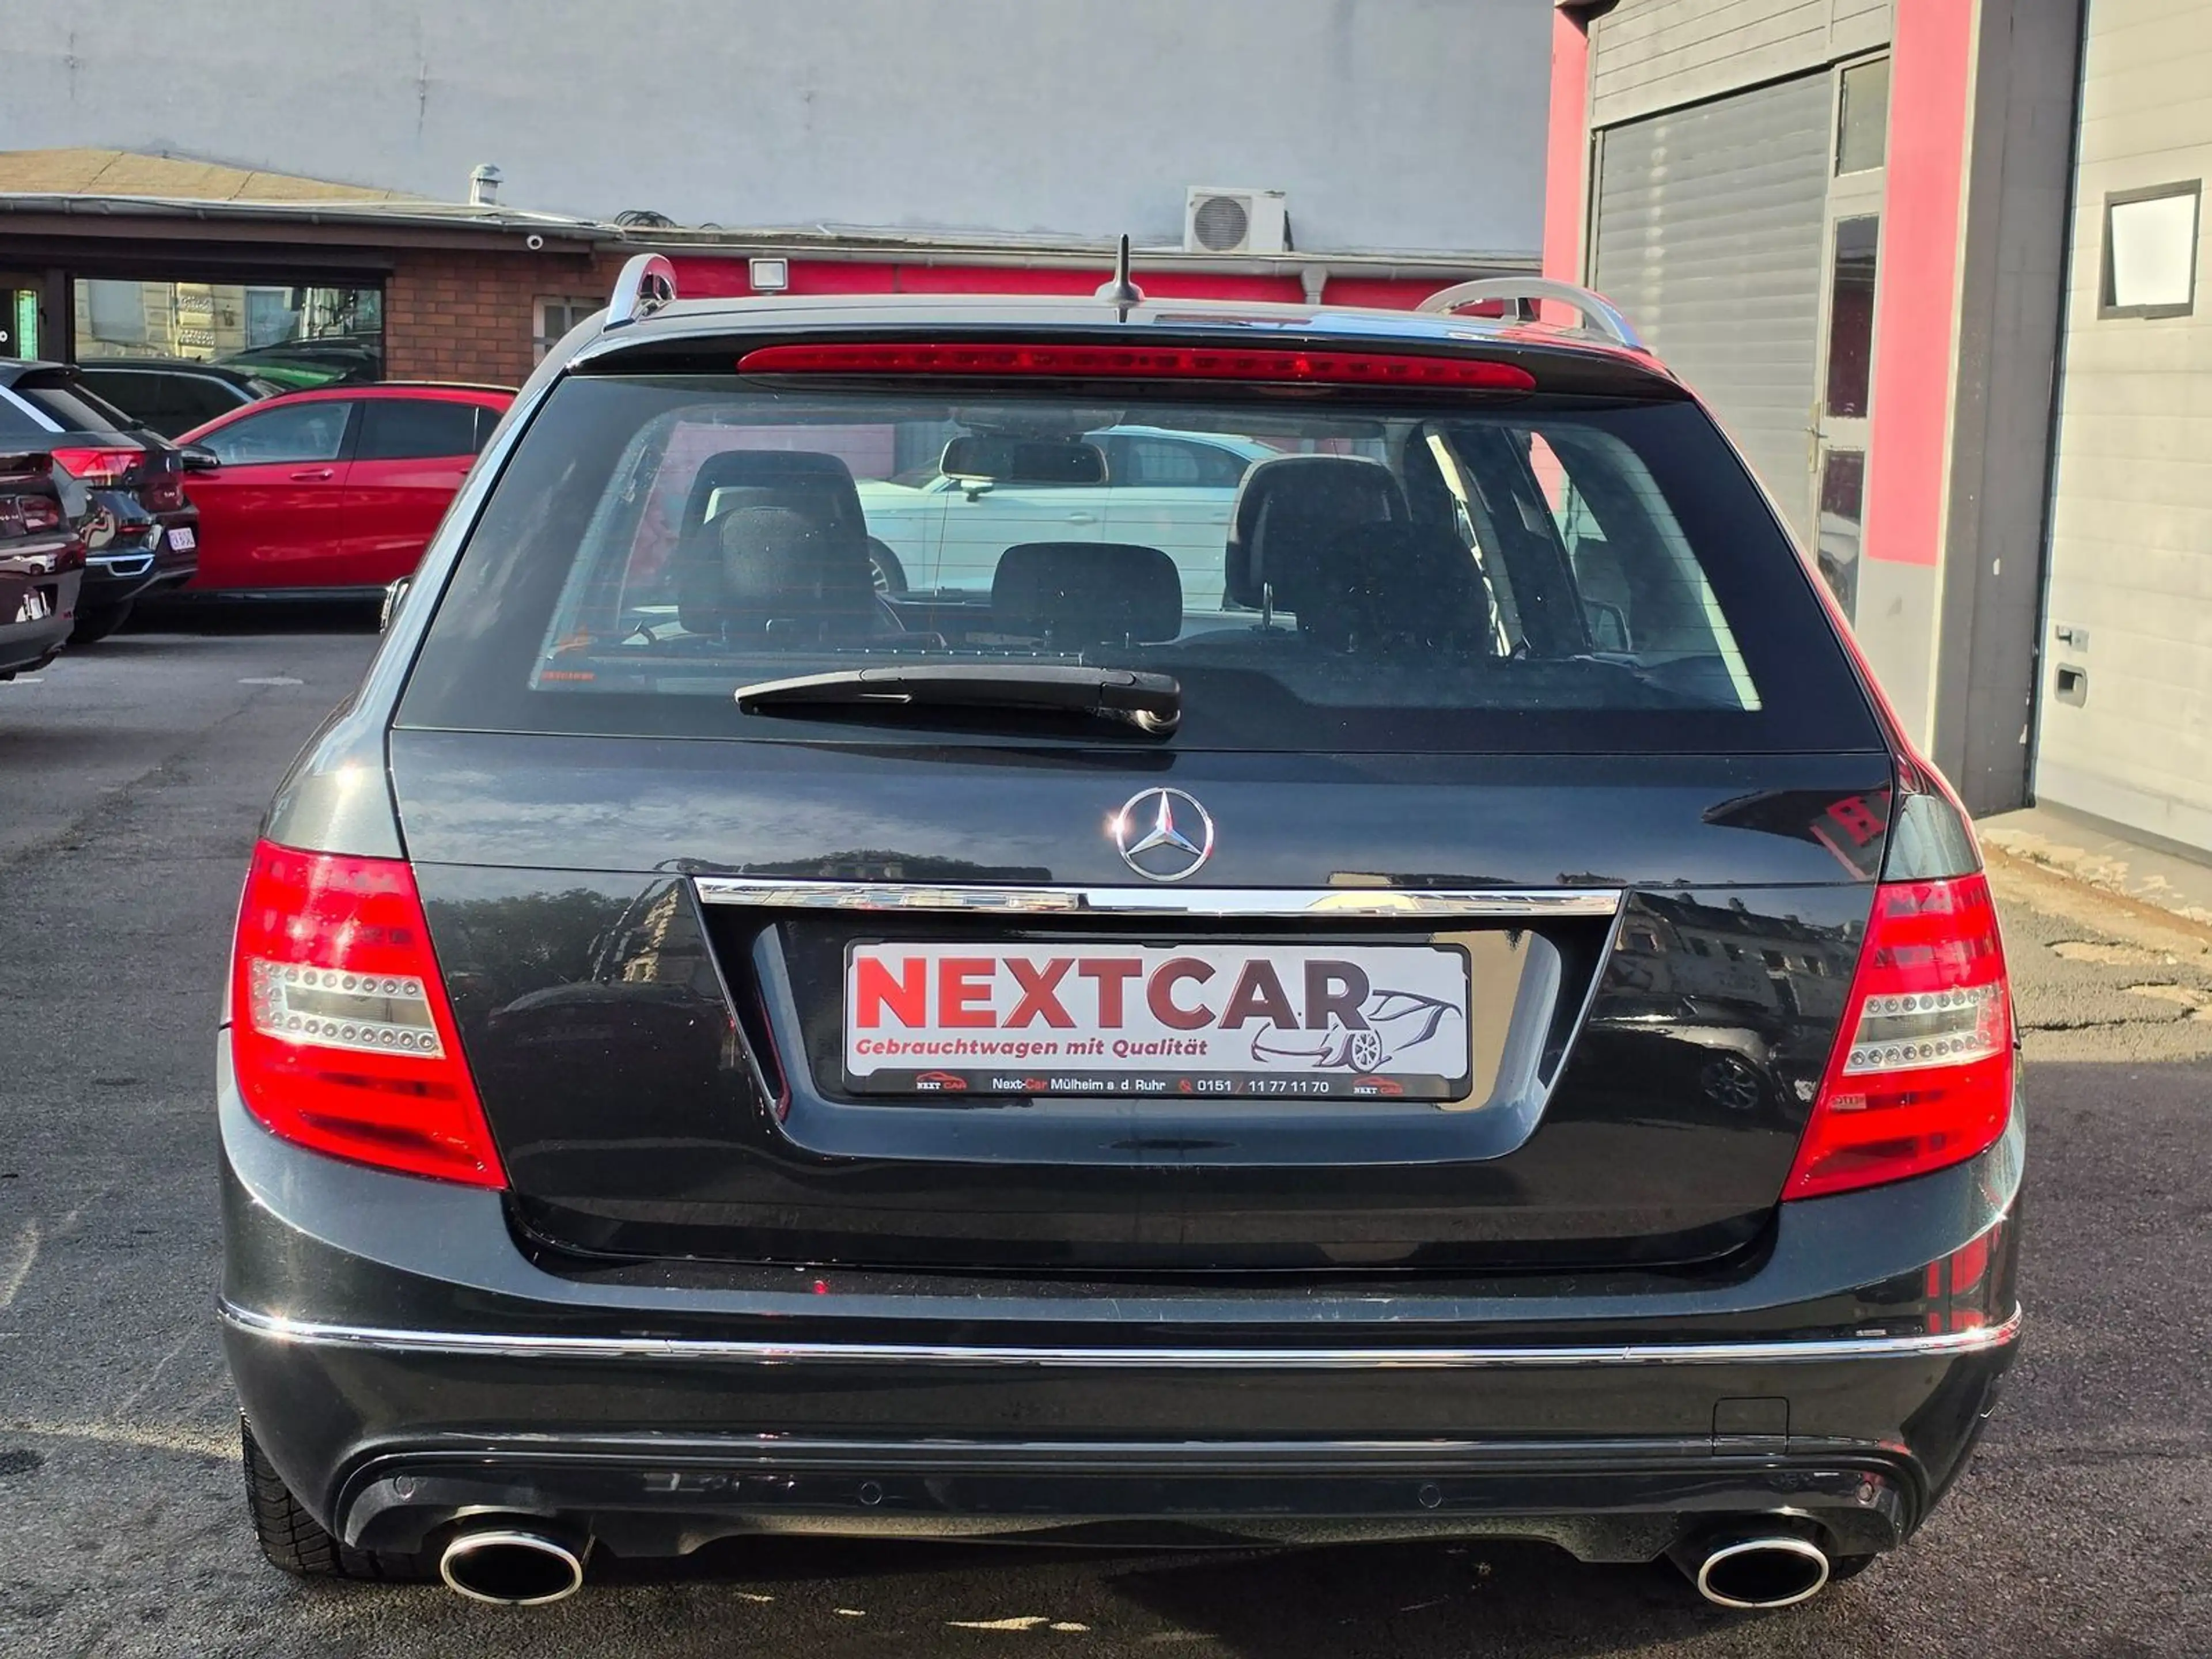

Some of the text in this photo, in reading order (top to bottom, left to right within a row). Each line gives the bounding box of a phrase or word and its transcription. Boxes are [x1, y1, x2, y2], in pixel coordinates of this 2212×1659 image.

[857, 957, 1371, 1031] NEXTCAR
[856, 1038, 1208, 1059] Gebrauchtwagen mit Qualität
[1050, 1078, 1103, 1090] Mülheim
[1135, 1079, 1166, 1090] Ruhr
[1197, 1081, 1232, 1092] 0151
[1248, 1081, 1265, 1092] 11
[1270, 1081, 1287, 1092] 77
[1290, 1081, 1306, 1092] 11
[1312, 1081, 1330, 1093] 70
[1354, 1086, 1378, 1094] NEXT
